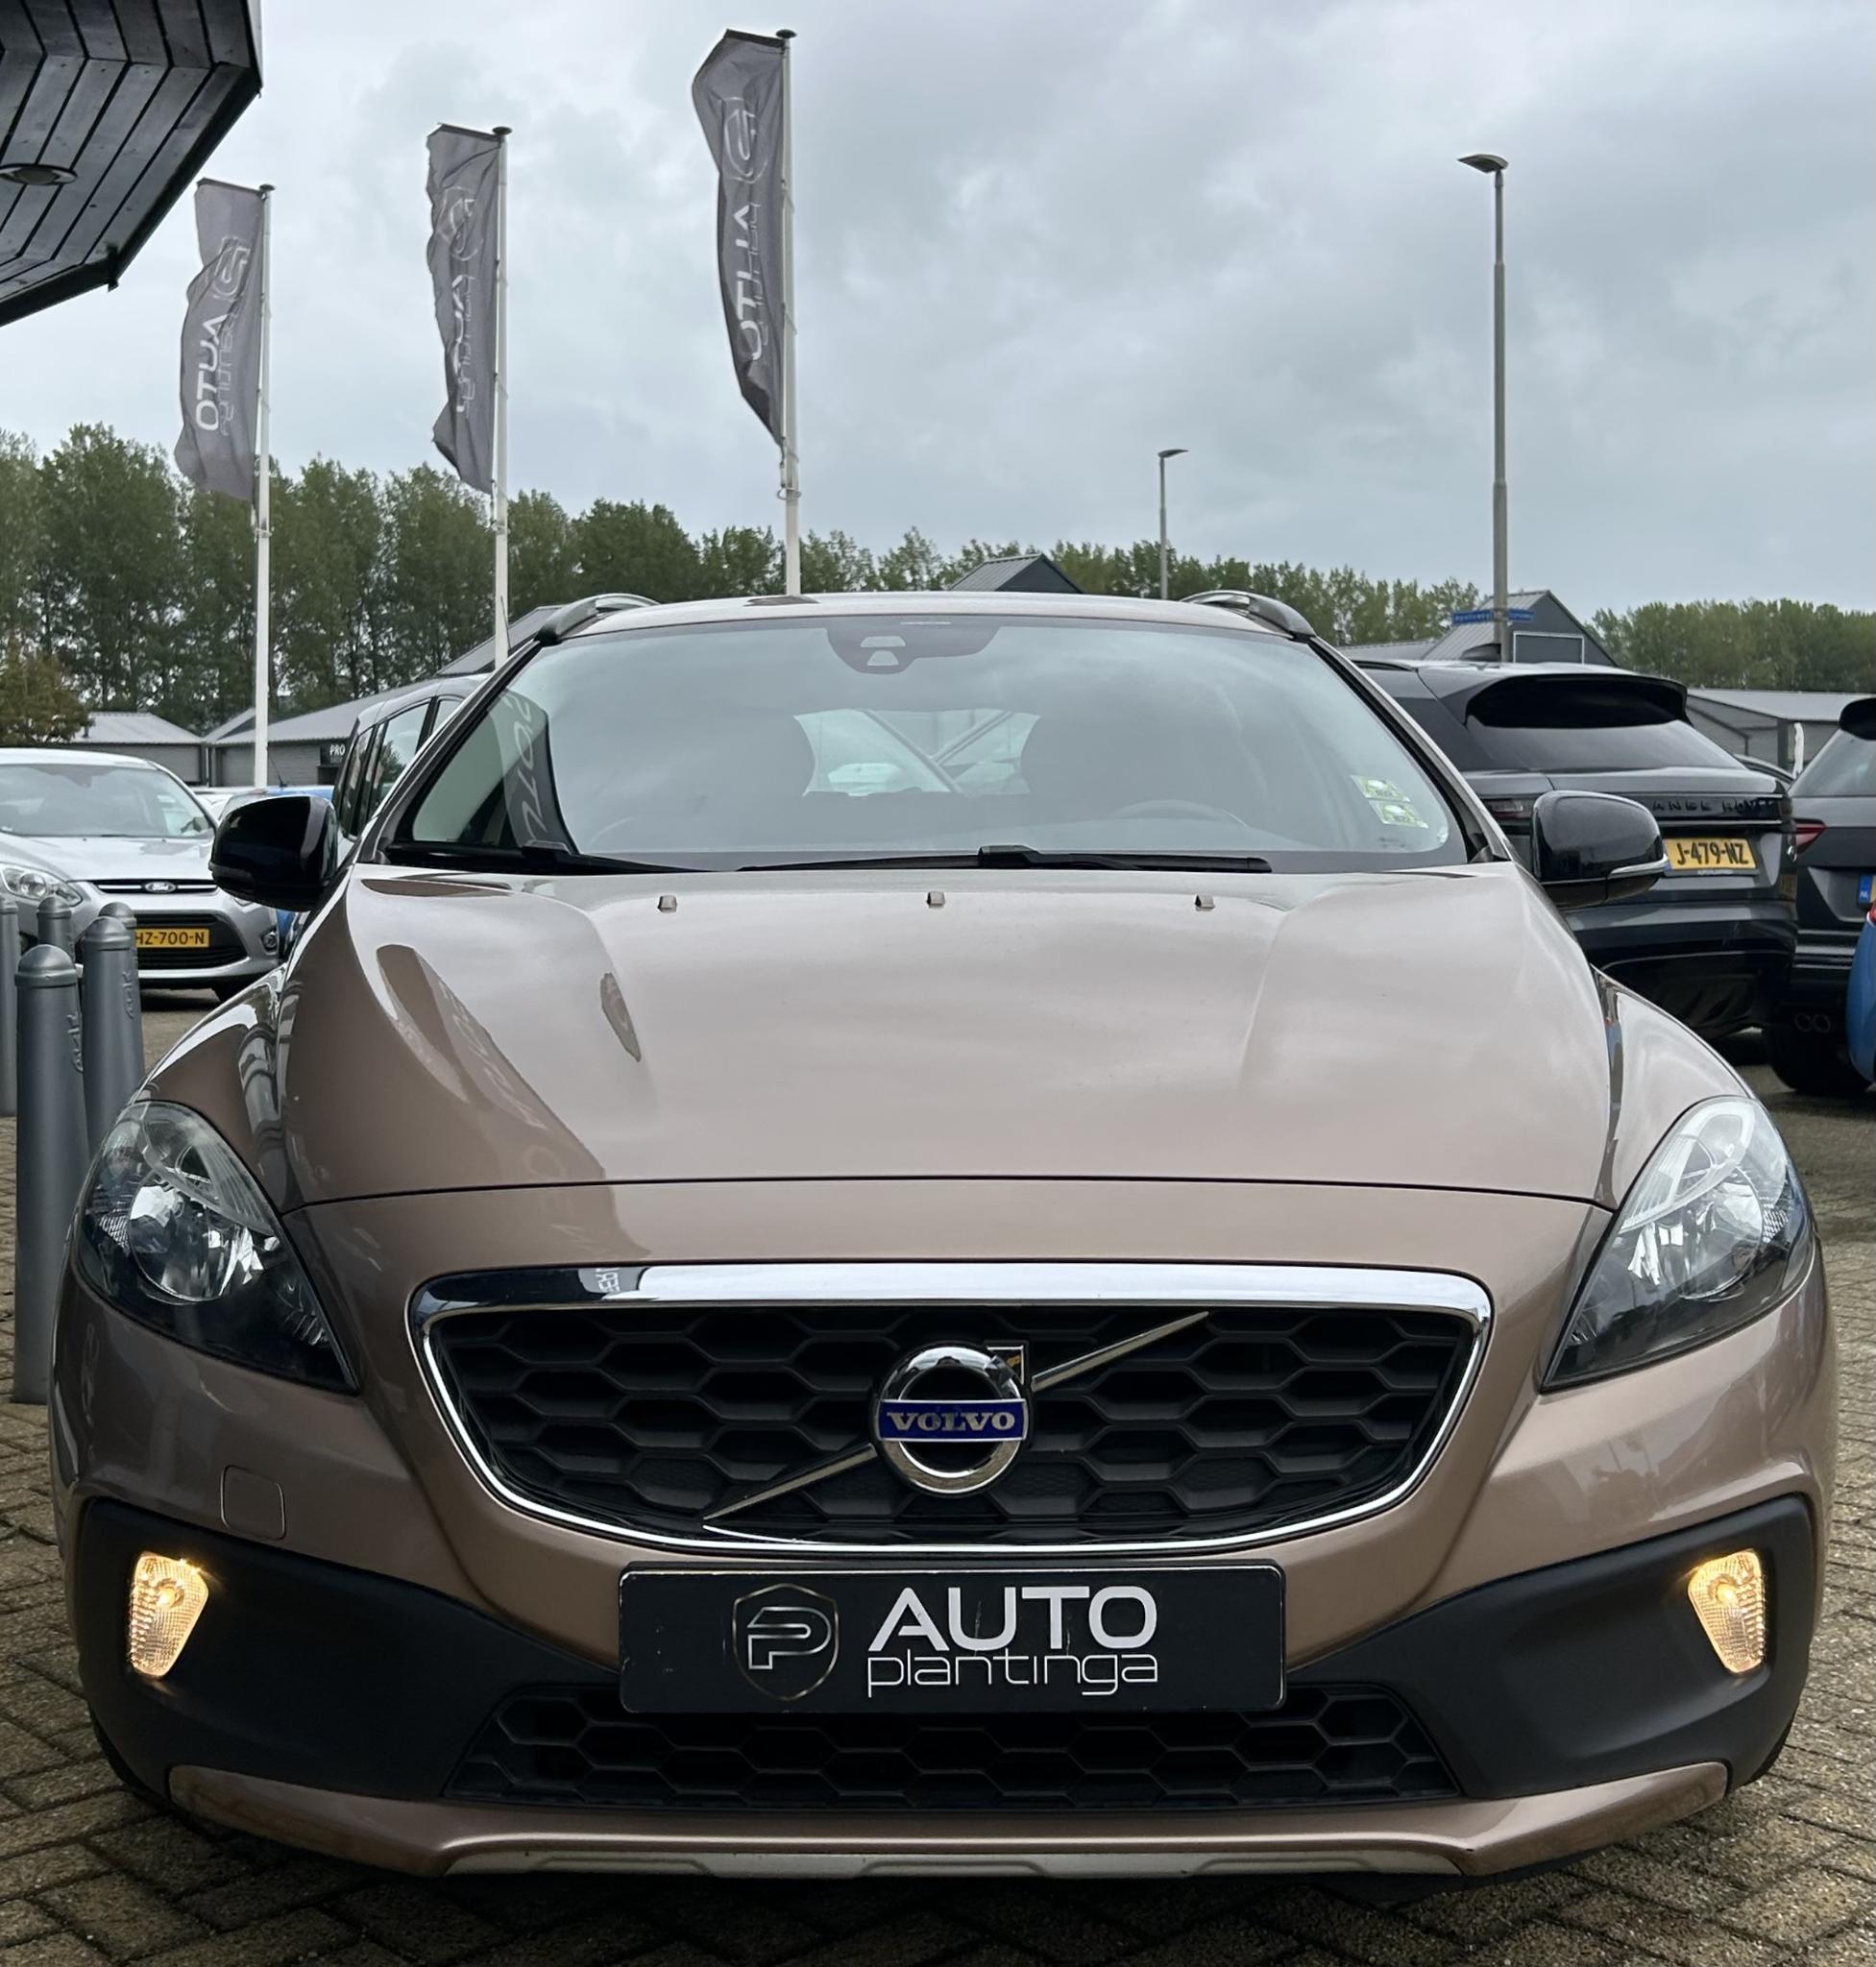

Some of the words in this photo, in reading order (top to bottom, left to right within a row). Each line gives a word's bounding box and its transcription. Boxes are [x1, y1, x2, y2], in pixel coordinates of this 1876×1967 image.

[329, 743, 346, 756] PRO
[1652, 799, 1712, 812] ANGE
[1676, 841, 1749, 865] J-479-NZ
[135, 932, 205, 945] HZ-700-N
[887, 1412, 1015, 1431] VOLVO
[868, 1585, 1157, 1652] AUTO
[867, 1647, 1158, 1698] plantinga
